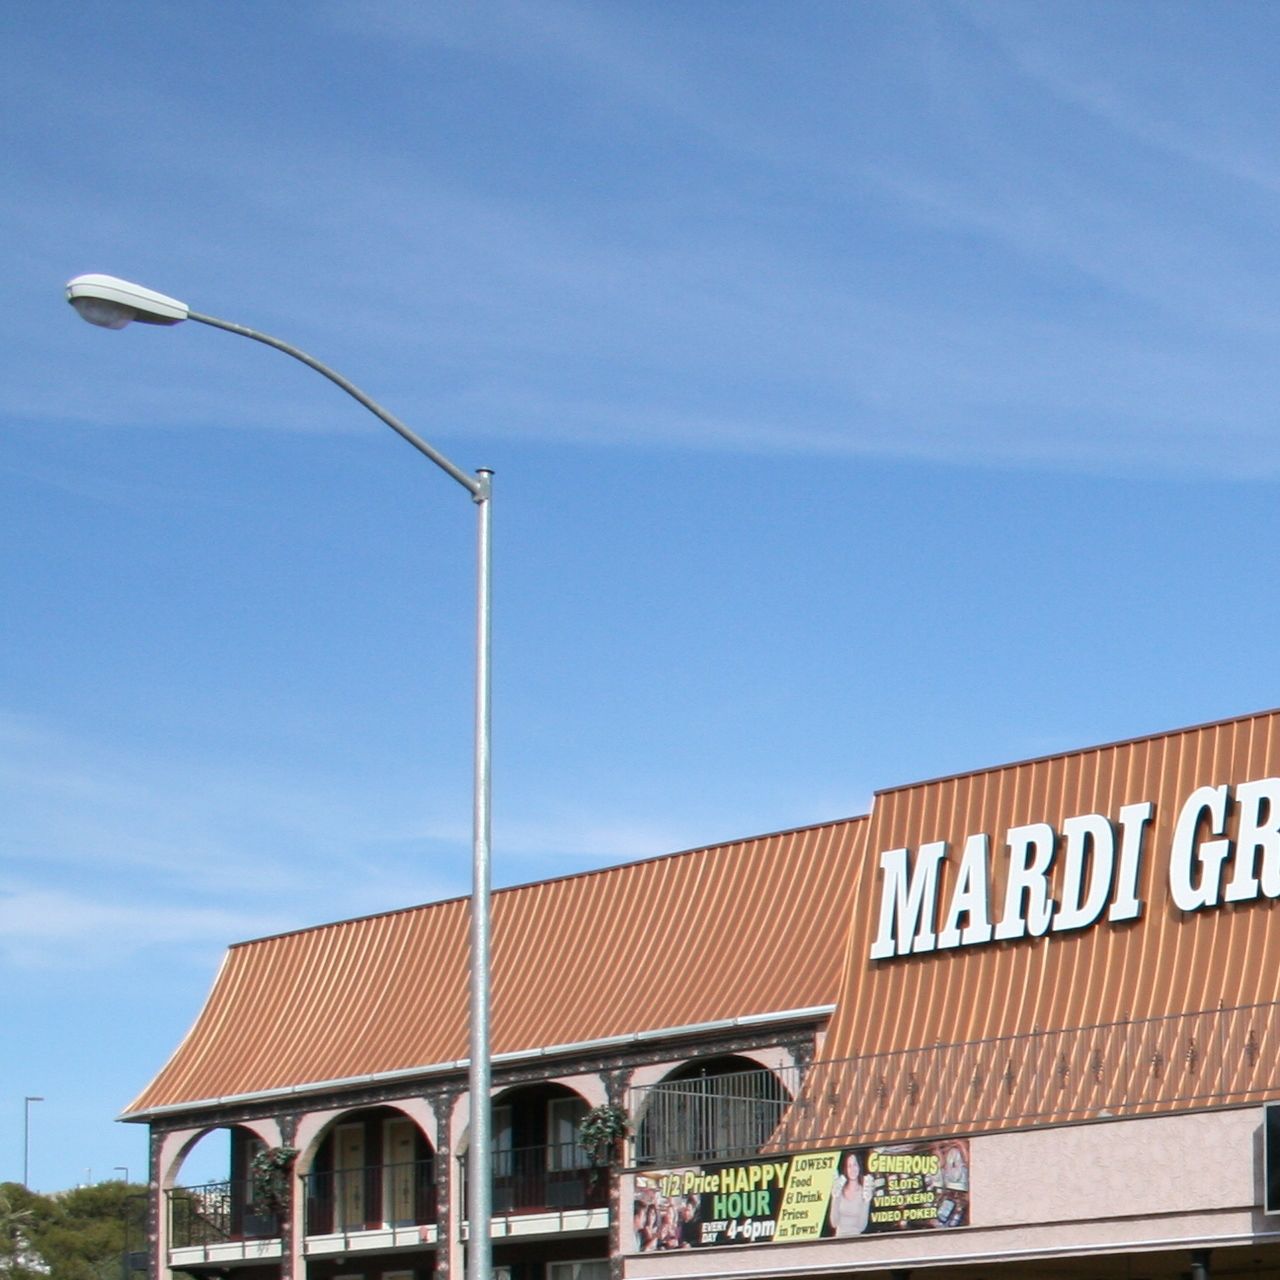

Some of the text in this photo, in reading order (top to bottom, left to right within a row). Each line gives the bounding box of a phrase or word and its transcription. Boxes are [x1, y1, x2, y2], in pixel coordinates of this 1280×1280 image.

[870, 801, 1153, 960] MARDI
[794, 1157, 834, 1172] LOWEST
[867, 1152, 939, 1174] GENEROUS
[662, 1162, 789, 1197] 1/2 Price HAPPY
[790, 1175, 813, 1188] Food
[888, 1178, 920, 1190] SLOTS
[786, 1190, 823, 1204] & Drink
[873, 1192, 935, 1207] VIDEO KENO
[713, 1190, 771, 1220] HOUR
[782, 1208, 809, 1220] Prices
[871, 1207, 938, 1223] VIDEO POKER
[701, 1221, 728, 1233] EVERY
[727, 1219, 775, 1241] 4-6pm
[779, 1223, 819, 1236] in Town!
[701, 1232, 719, 1243] DAY
